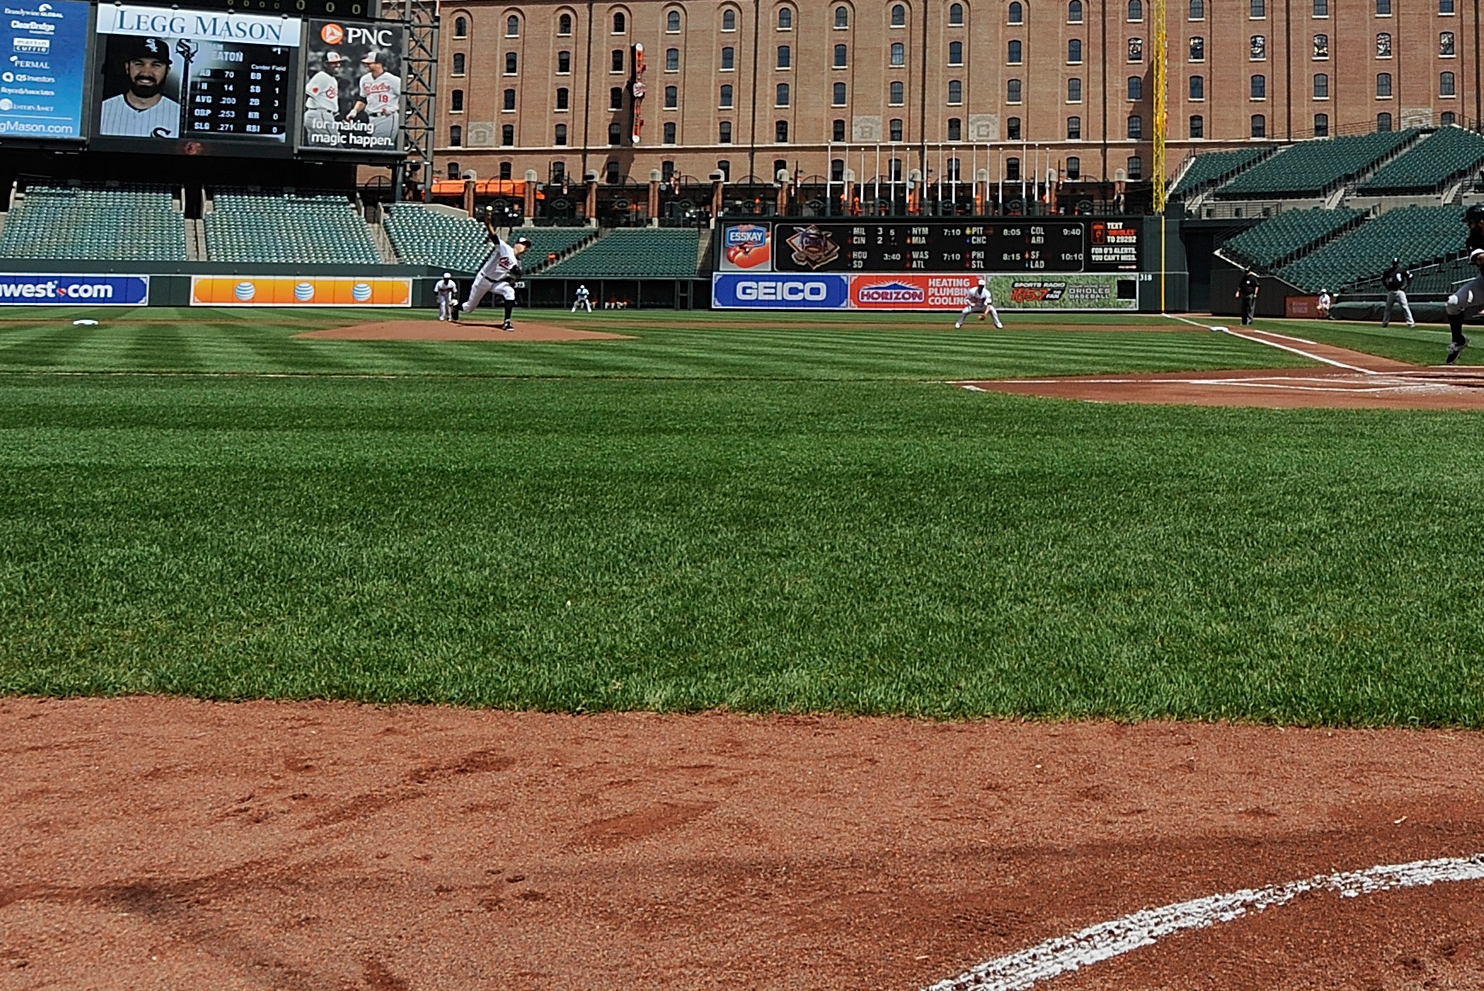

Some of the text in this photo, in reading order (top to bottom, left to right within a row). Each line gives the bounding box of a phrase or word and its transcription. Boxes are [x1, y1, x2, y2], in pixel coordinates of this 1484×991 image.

[324, 1, 335, 13] 0
[351, 3, 361, 15] 0
[118, 10, 283, 41] LEGG MASON
[346, 27, 393, 47] PNC
[213, 51, 244, 62] EATON
[15, 60, 50, 70] PERMAL
[225, 71, 235, 79] 70
[224, 84, 234, 92] 14
[249, 85, 261, 93] SB
[195, 95, 213, 104] AVG
[220, 97, 237, 105] .200
[194, 108, 213, 117] OBP
[218, 110, 236, 118] .253
[194, 122, 211, 130] SLG
[217, 124, 235, 132] .271
[312, 118, 375, 135] for making
[311, 132, 396, 148] magic happen.
[877, 227, 883, 235] 3
[912, 227, 929, 235] NYM
[971, 227, 984, 235] PIT
[1030, 226, 1045, 235] COL
[730, 232, 763, 241] ESSKAY
[853, 236, 1044, 244] CIN 2 MIA CHC ARI
[852, 251, 868, 259] HOU
[883, 253, 901, 261] 3:40
[912, 251, 929, 259] WAS
[971, 251, 984, 259] PHI
[1003, 253, 1021, 261] 8:15
[1030, 251, 1040, 259] SF
[853, 260, 1045, 269] SD ATL STL LAD
[928, 279, 970, 287] HEATING
[736, 282, 827, 301] GEICO
[861, 291, 923, 301] HORIZON
[928, 288, 970, 296] PLUMBIN
